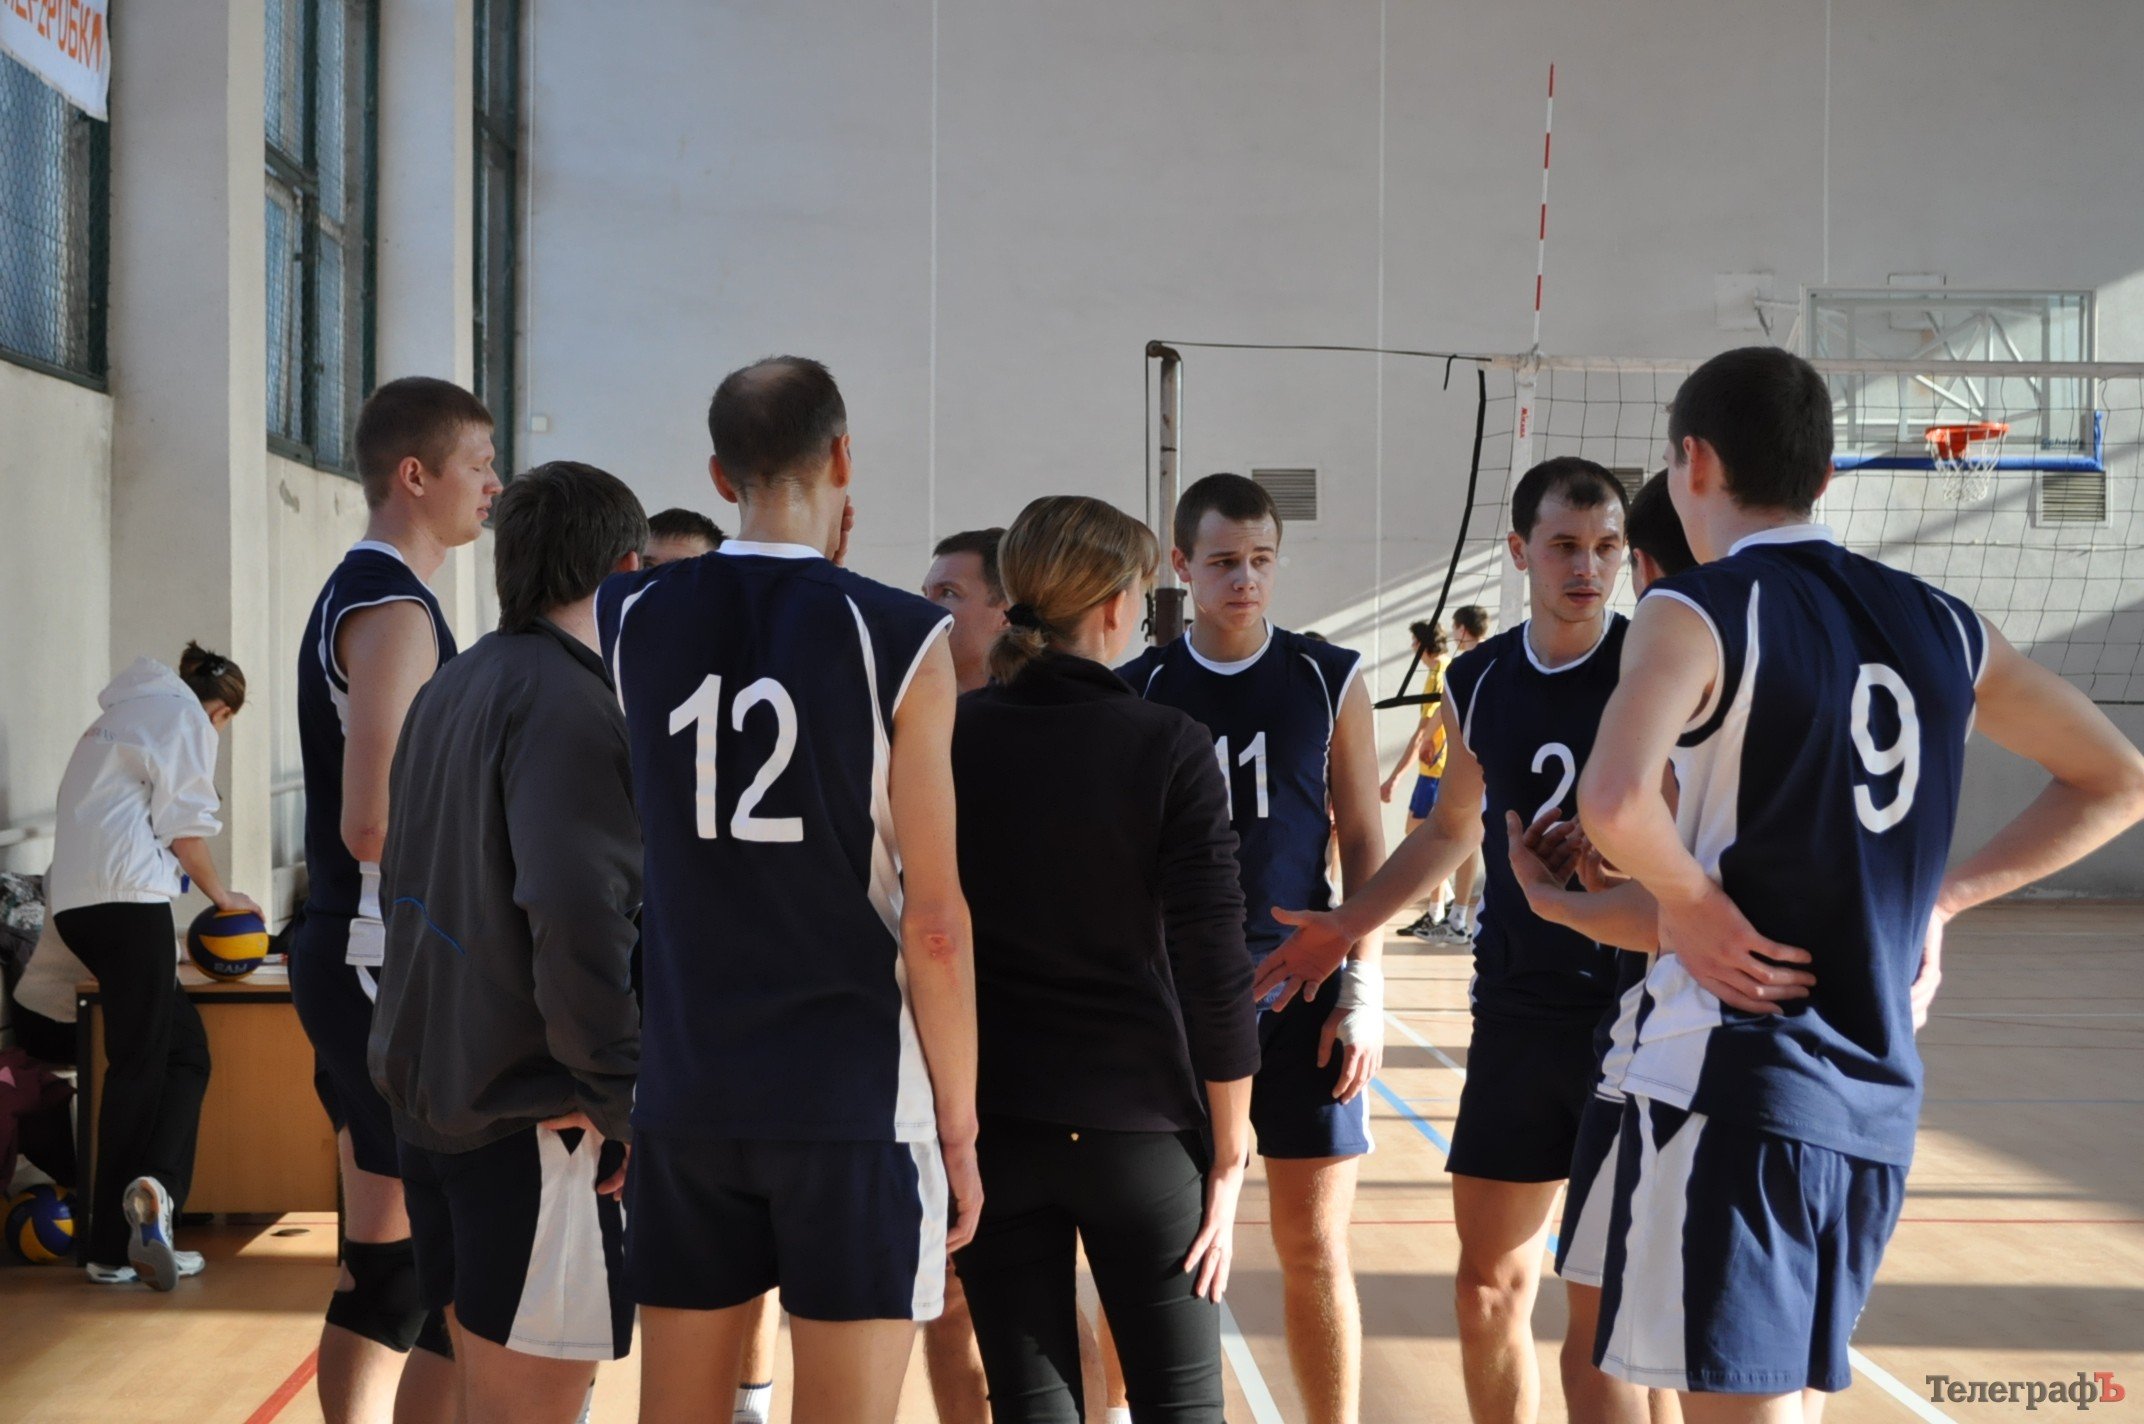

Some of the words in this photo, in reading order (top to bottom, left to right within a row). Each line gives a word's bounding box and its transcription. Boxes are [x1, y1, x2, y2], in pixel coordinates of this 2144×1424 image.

[668, 673, 804, 842] 12
[1214, 731, 1269, 821] 11
[1531, 742, 1576, 836] 2
[1851, 663, 1920, 833] 9
